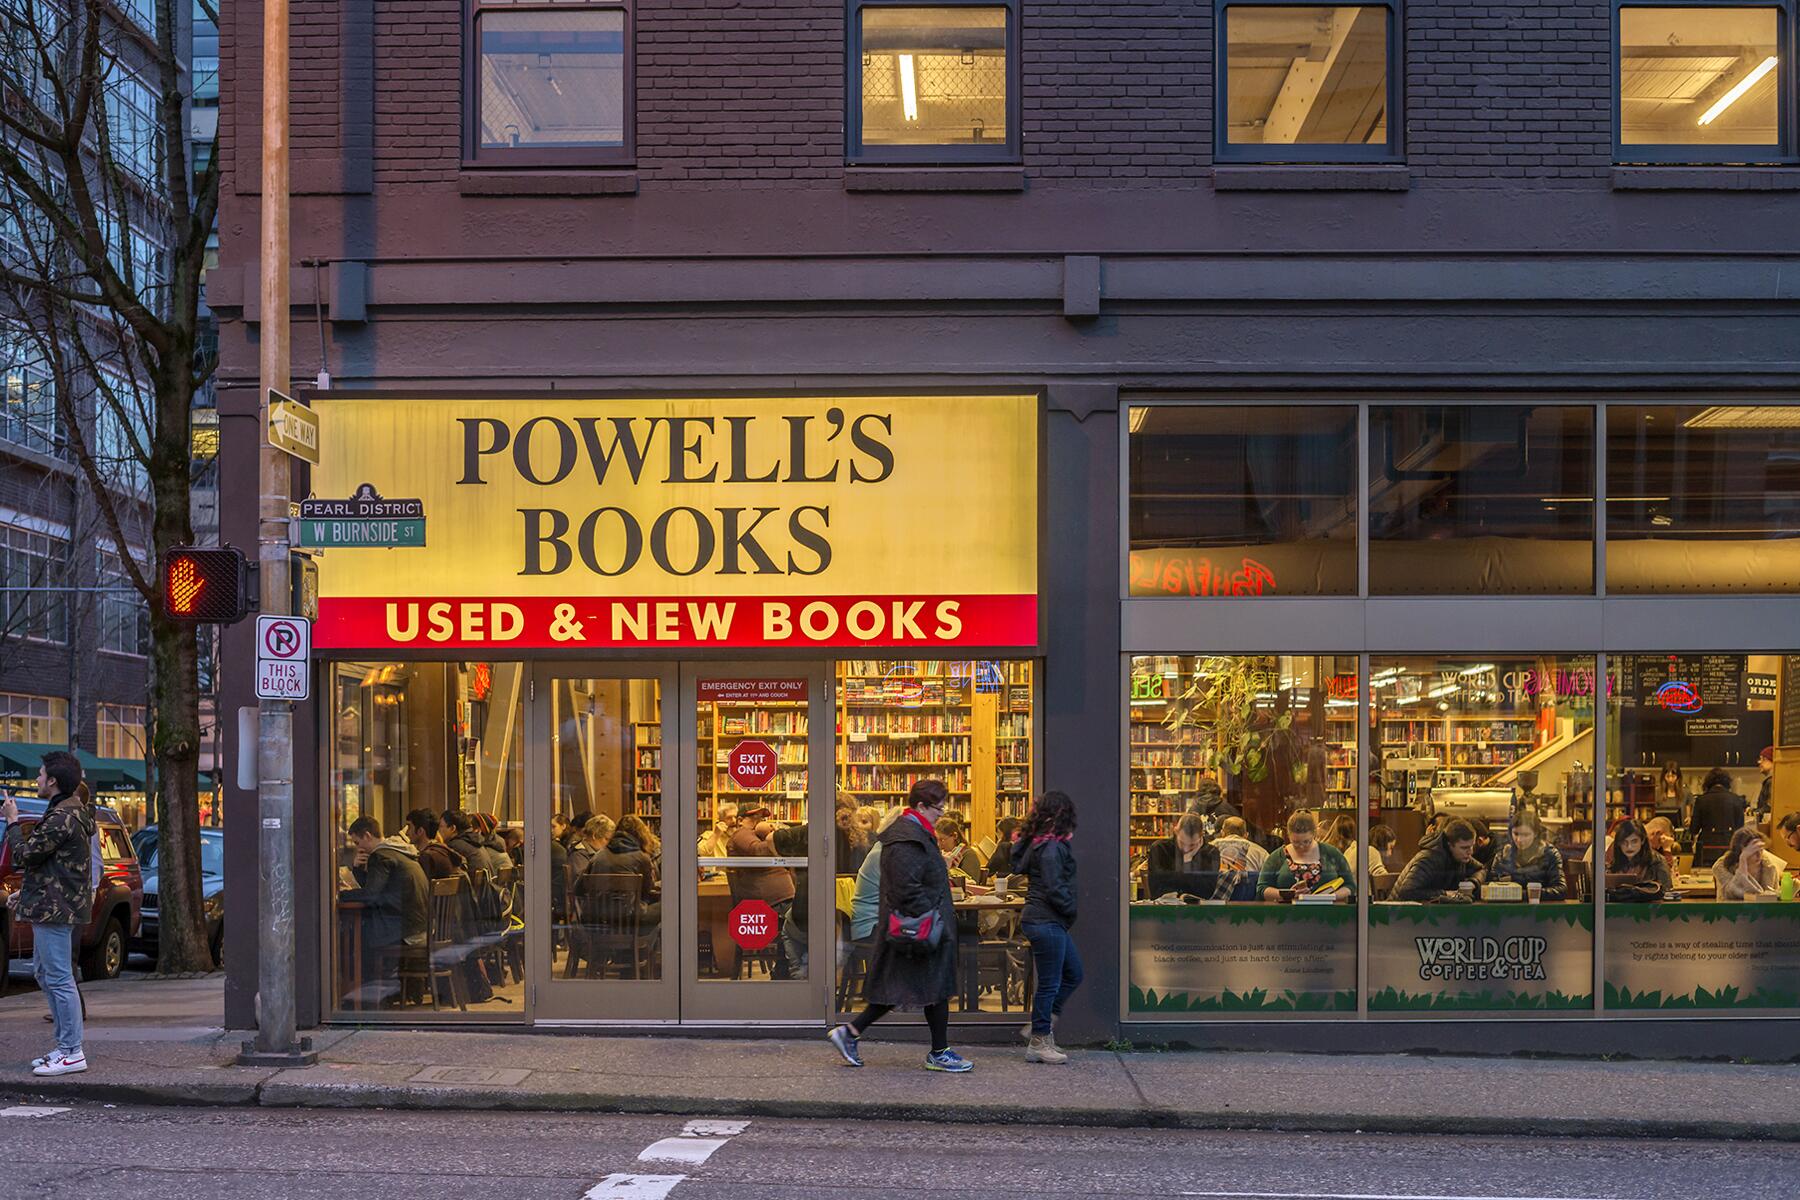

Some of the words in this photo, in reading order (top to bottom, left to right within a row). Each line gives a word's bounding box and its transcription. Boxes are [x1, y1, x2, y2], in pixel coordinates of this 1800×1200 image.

[283, 413, 299, 440] ONE
[300, 421, 315, 447] WAY
[455, 407, 895, 486] POWELL'S
[303, 503, 354, 515] PEARL
[360, 502, 421, 515] DISTRICT
[313, 522, 325, 542] W
[332, 521, 399, 543] BURNSIDE
[404, 525, 415, 537] ST
[516, 504, 833, 577] BOOKS
[386, 602, 525, 642] USED
[549, 602, 588, 642] &
[611, 602, 737, 641] NEW
[762, 600, 963, 641] BOOKS
[269, 663, 297, 678] THIS
[262, 677, 301, 692] BLOCK
[701, 681, 756, 690] EMERGENCY
[758, 681, 778, 690] EXIT
[779, 681, 803, 690] ONLY
[1441, 671, 1496, 691] WORLD
[1502, 671, 1531, 690] CUP
[1747, 677, 1777, 688] ORDE
[1507, 689, 1531, 703] TEA
[739, 754, 766, 764] EXIT
[737, 765, 767, 775] ONLY
[740, 914, 766, 924] EXIT
[738, 925, 768, 935] ONLY
[1415, 937, 1499, 965] WORLD
[1503, 936, 1547, 965] CUP
[1674, 942, 1692, 950] way
[1692, 941, 1701, 949] of
[1701, 941, 1735, 950] stealing
[1249, 954, 1270, 962] hard
[1271, 954, 1281, 962] to
[1669, 952, 1696, 961] belong
[1697, 952, 1707, 960] to
[1707, 952, 1728, 961] your
[1727, 951, 1748, 960] older
[1419, 963, 1487, 980] COFFEE
[1490, 956, 1510, 978] &
[1510, 964, 1546, 980] TEA
